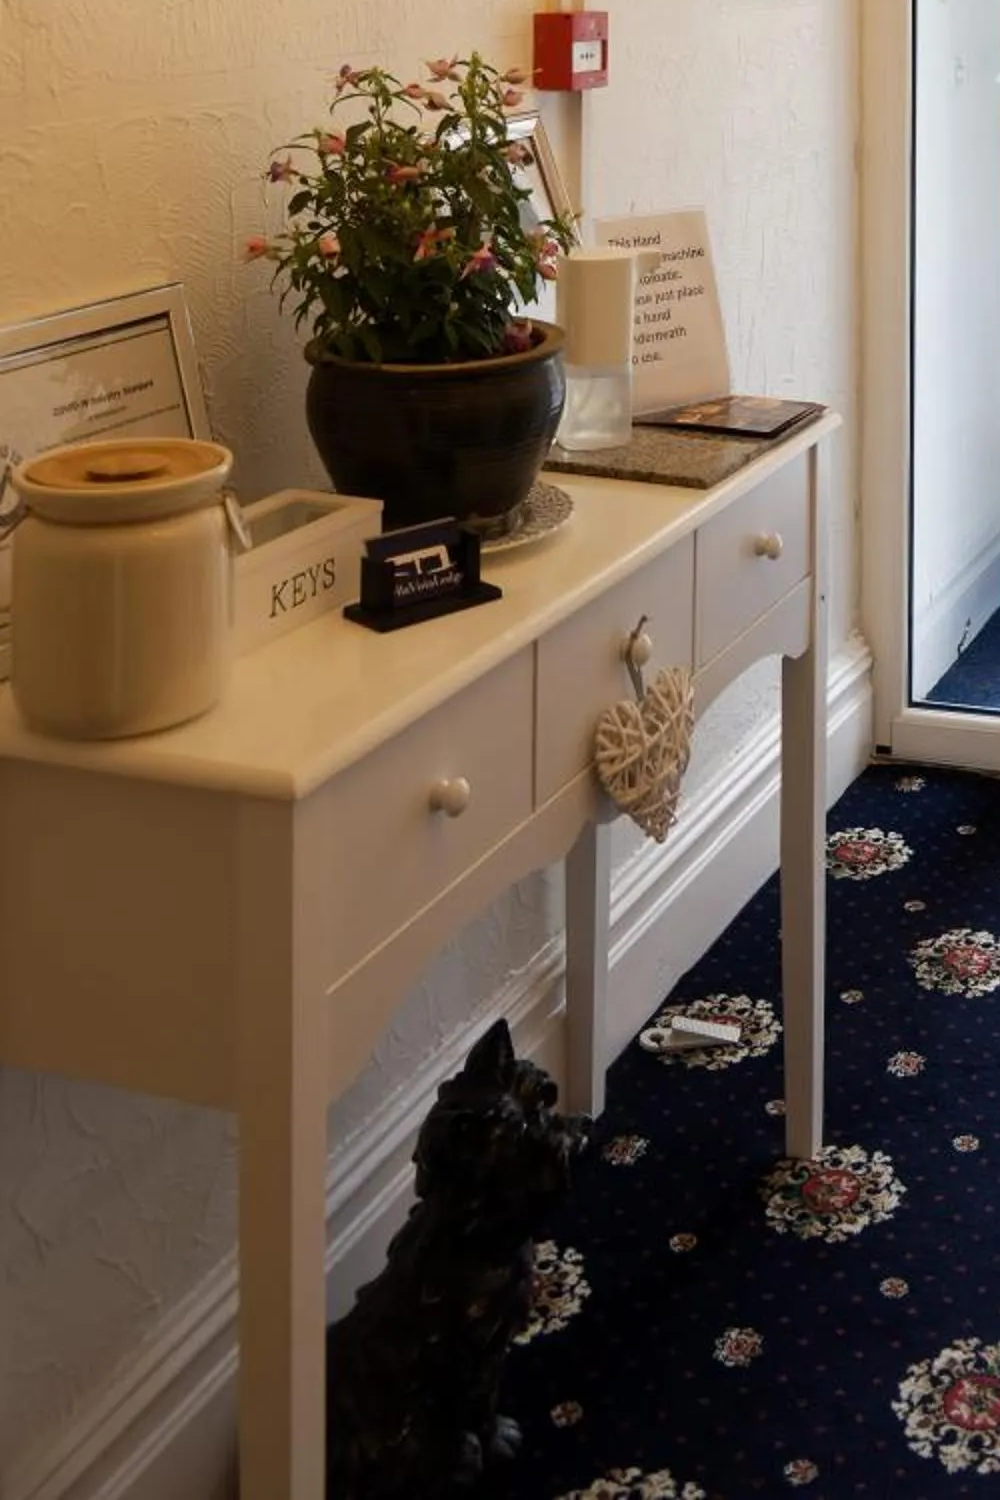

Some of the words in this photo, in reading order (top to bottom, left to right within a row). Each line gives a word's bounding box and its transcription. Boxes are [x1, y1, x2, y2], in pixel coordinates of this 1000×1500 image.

[608, 236, 631, 249] This
[633, 233, 661, 248] Hand
[661, 247, 705, 261] machine
[655, 289, 674, 304] just
[677, 286, 704, 301] place
[643, 308, 671, 323] hand
[269, 557, 336, 618] KEYS
